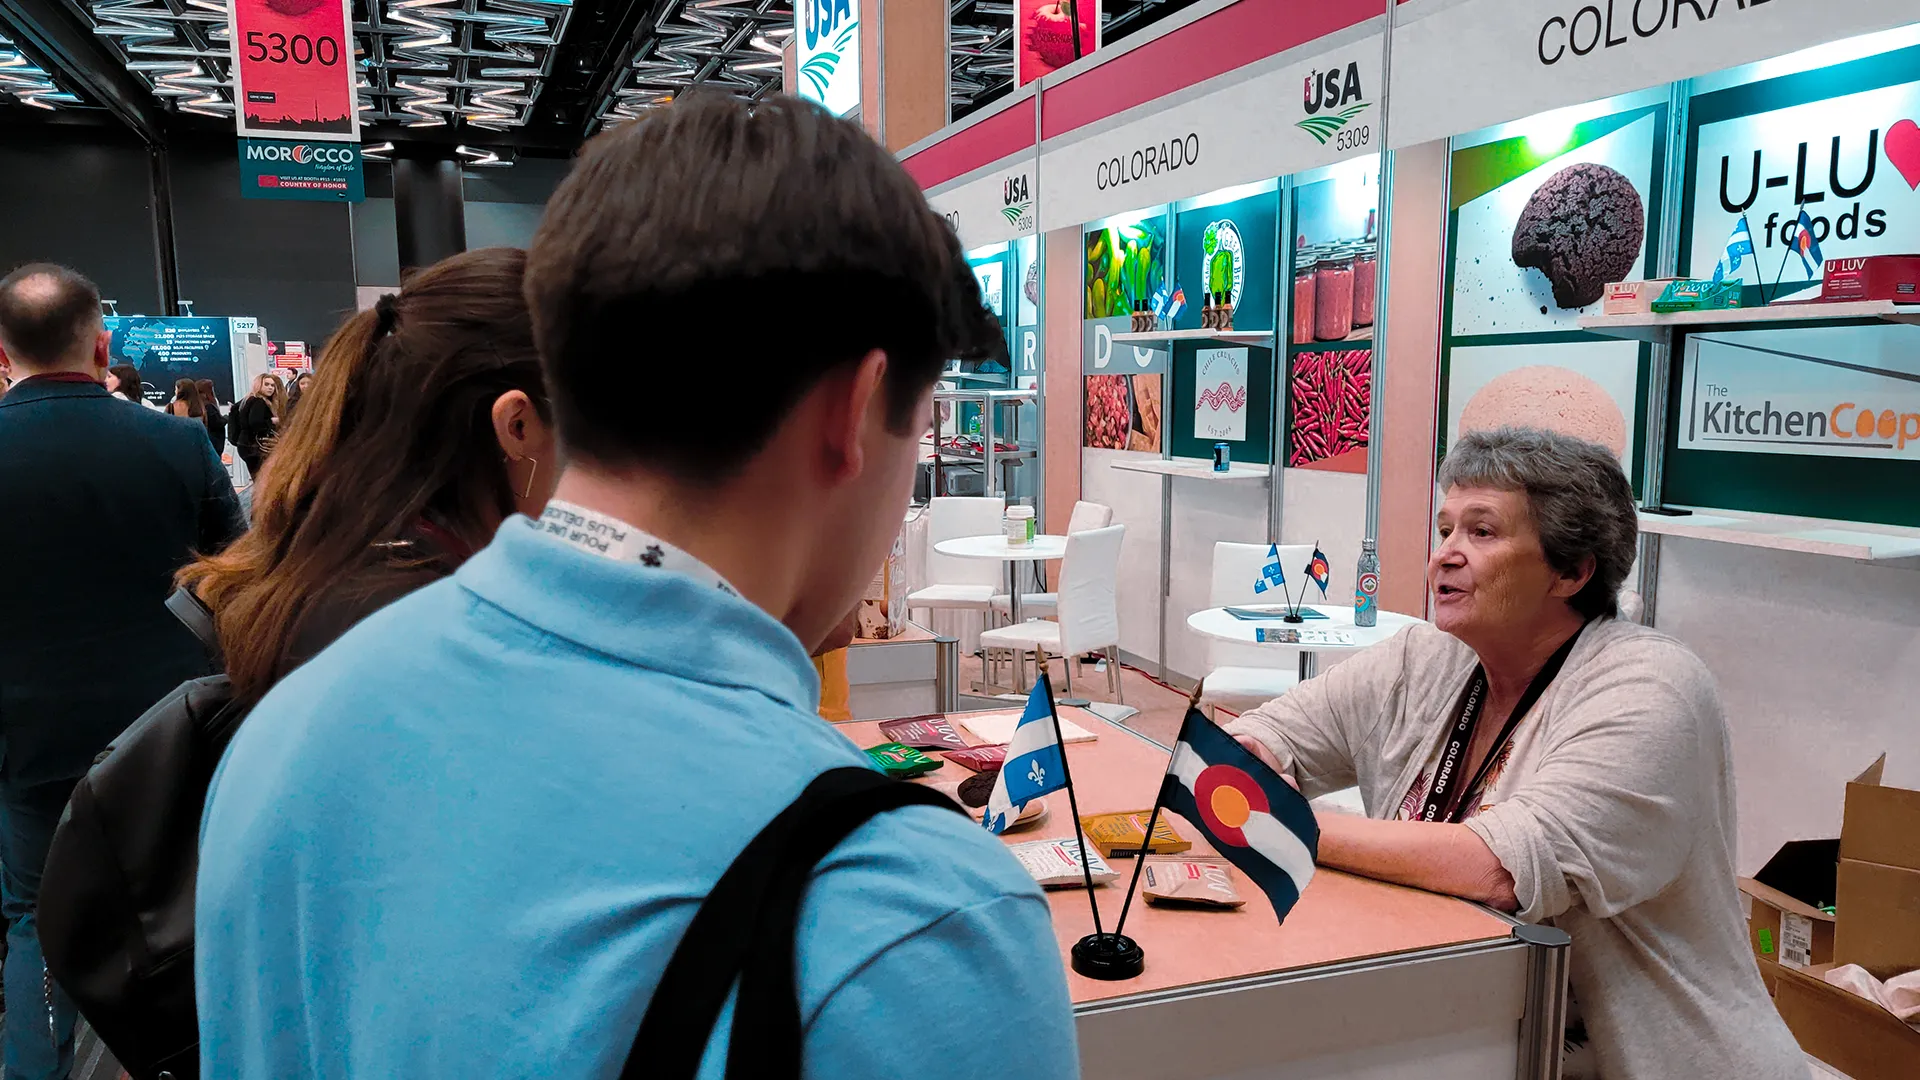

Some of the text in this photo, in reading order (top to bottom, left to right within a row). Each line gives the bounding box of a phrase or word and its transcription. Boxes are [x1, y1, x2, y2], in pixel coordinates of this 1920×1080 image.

[1538, 0, 1771, 65] COLOR
[247, 32, 338, 66] 5300
[1304, 61, 1363, 115] USA
[1337, 125, 1370, 152] 5309
[247, 145, 354, 164] MOROCCO
[1097, 133, 1199, 190] COLORADO
[1004, 174, 1029, 205] USA
[1018, 216, 1033, 232] 5309
[1841, 258, 1867, 270] LUV
[1620, 284, 1640, 294] LUV
[1202, 353, 1216, 376] CHILE
[1707, 384, 1728, 397] The
[546, 522, 568, 538] UNE
[569, 530, 608, 552] POUR
[587, 520, 627, 542] PLUS
[1459, 678, 1482, 731] COLORADO
[1436, 740, 1460, 794] COLORADO
